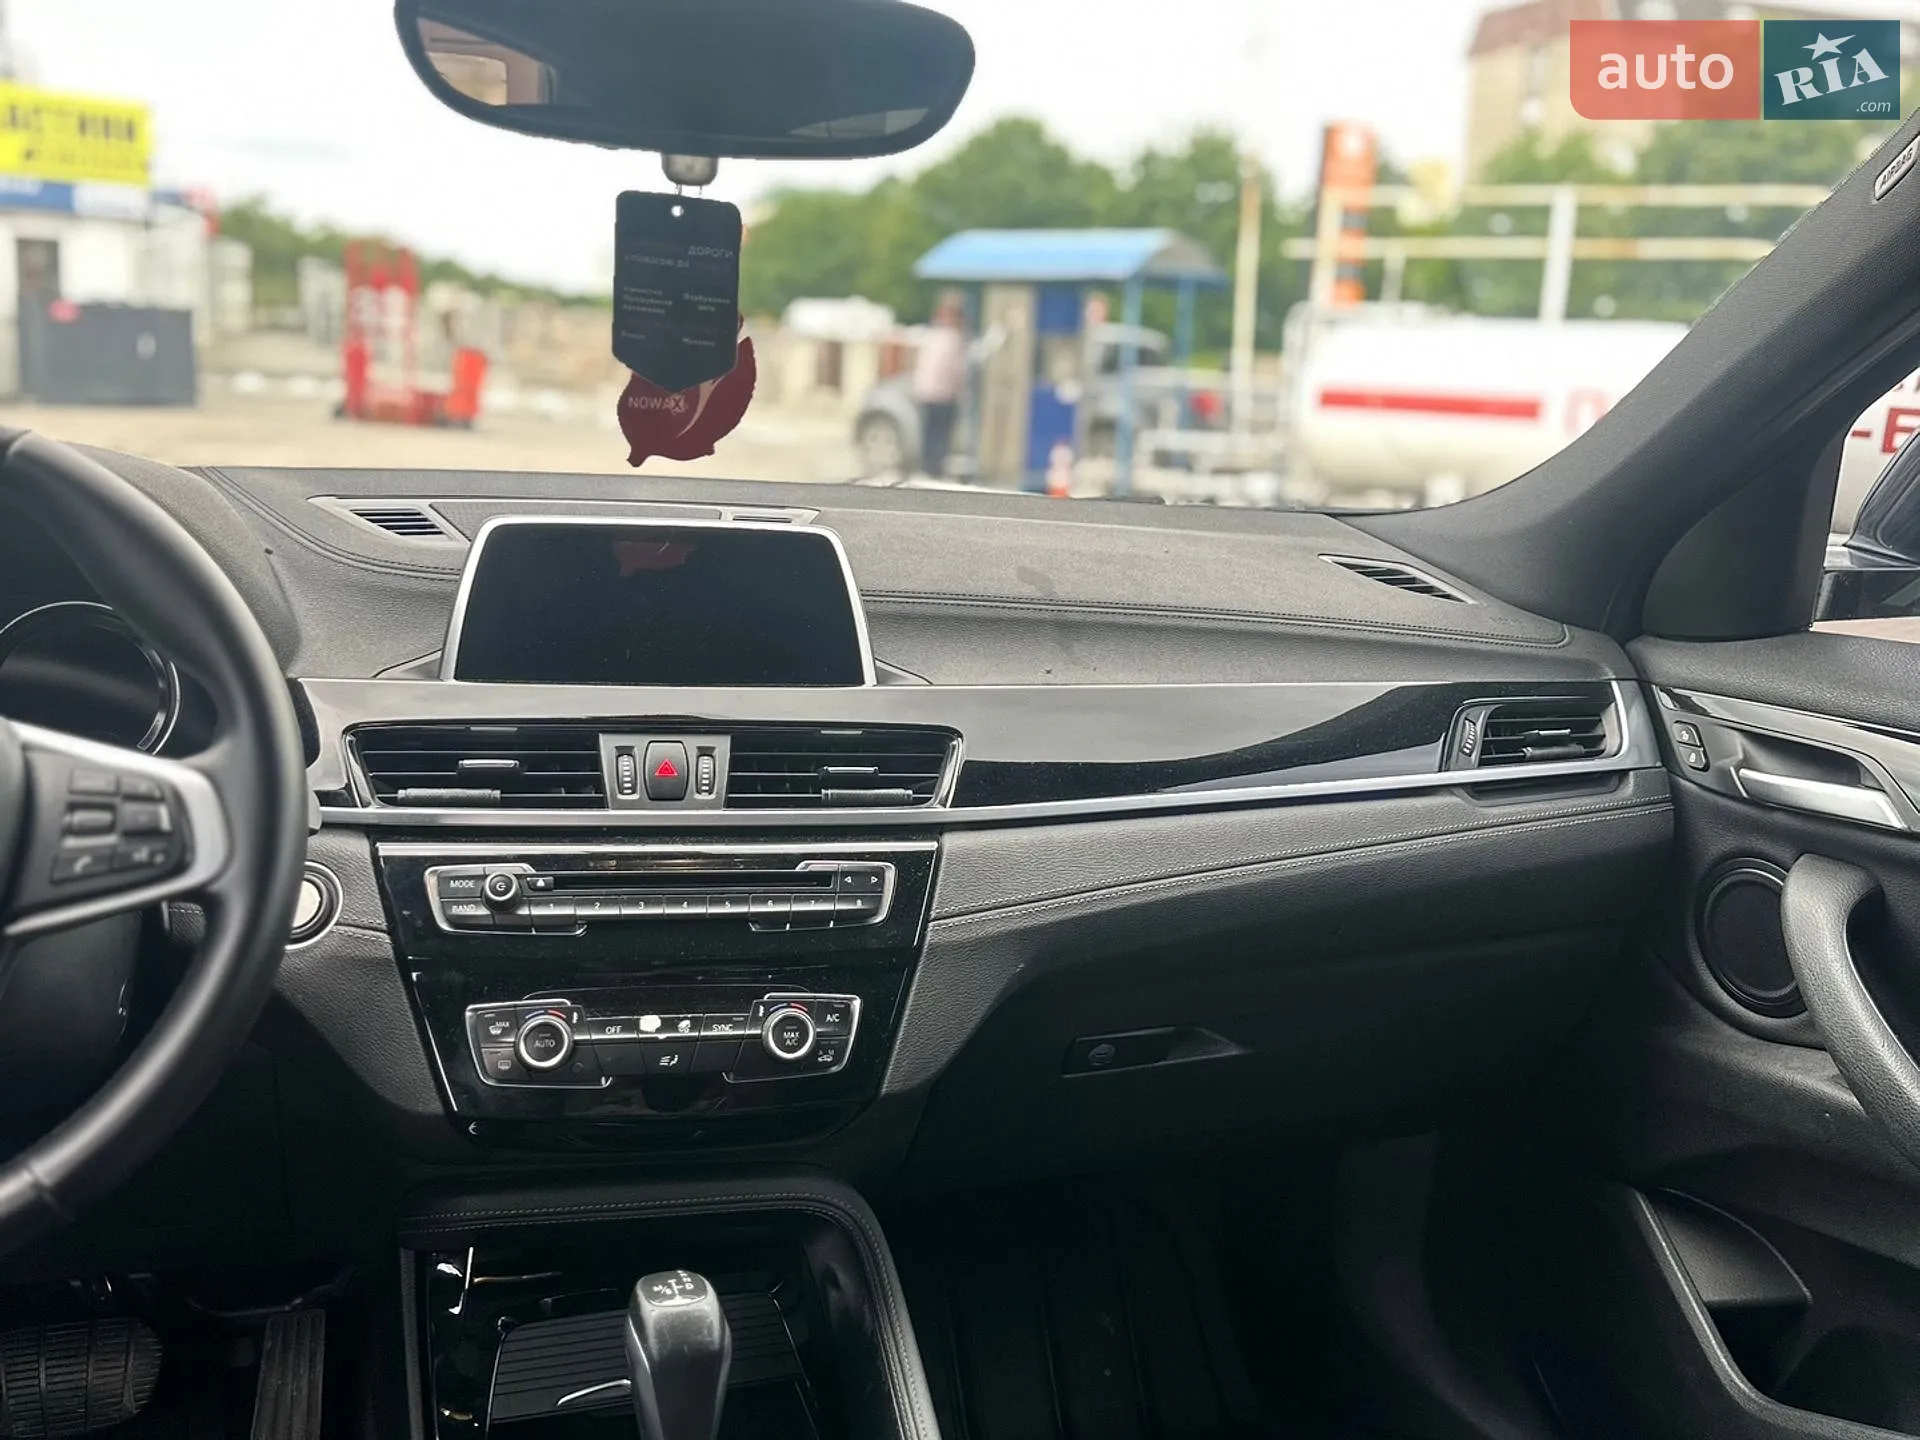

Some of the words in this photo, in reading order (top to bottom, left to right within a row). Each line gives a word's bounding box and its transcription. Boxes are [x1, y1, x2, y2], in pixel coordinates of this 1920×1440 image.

[450, 880, 475, 889] MODE
[826, 1014, 840, 1023] A/C
[606, 1026, 622, 1034] OFF
[712, 1024, 733, 1032] SYNC
[534, 1040, 556, 1048] AUTO
